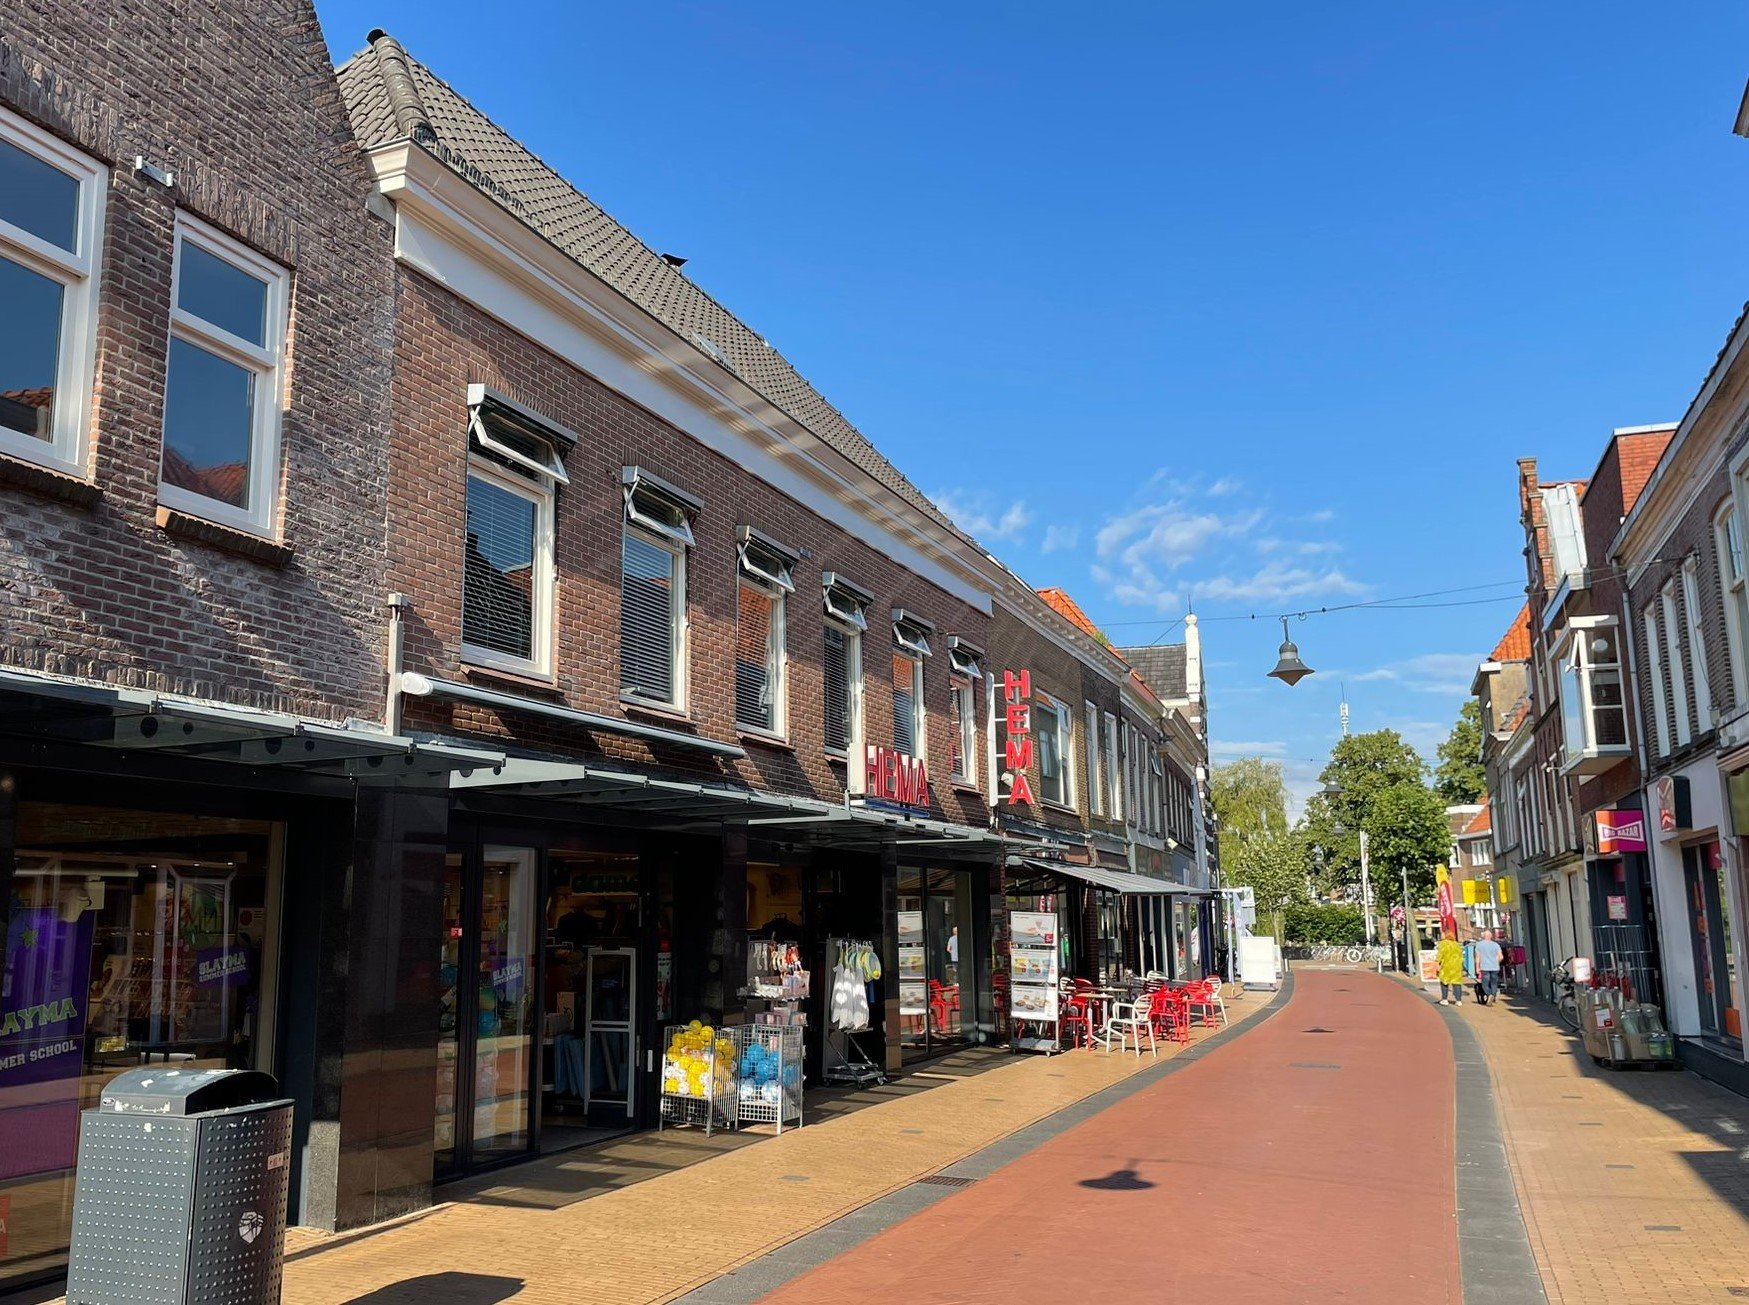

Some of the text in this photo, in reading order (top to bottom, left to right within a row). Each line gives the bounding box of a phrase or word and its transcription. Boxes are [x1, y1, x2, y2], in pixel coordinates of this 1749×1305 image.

[1004, 669, 1034, 805] HEMA
[865, 743, 930, 807] HEMA
[199, 951, 246, 976] SLAYMA
[0, 997, 78, 1036] AYMA
[30, 1040, 77, 1062] SCHOOL
